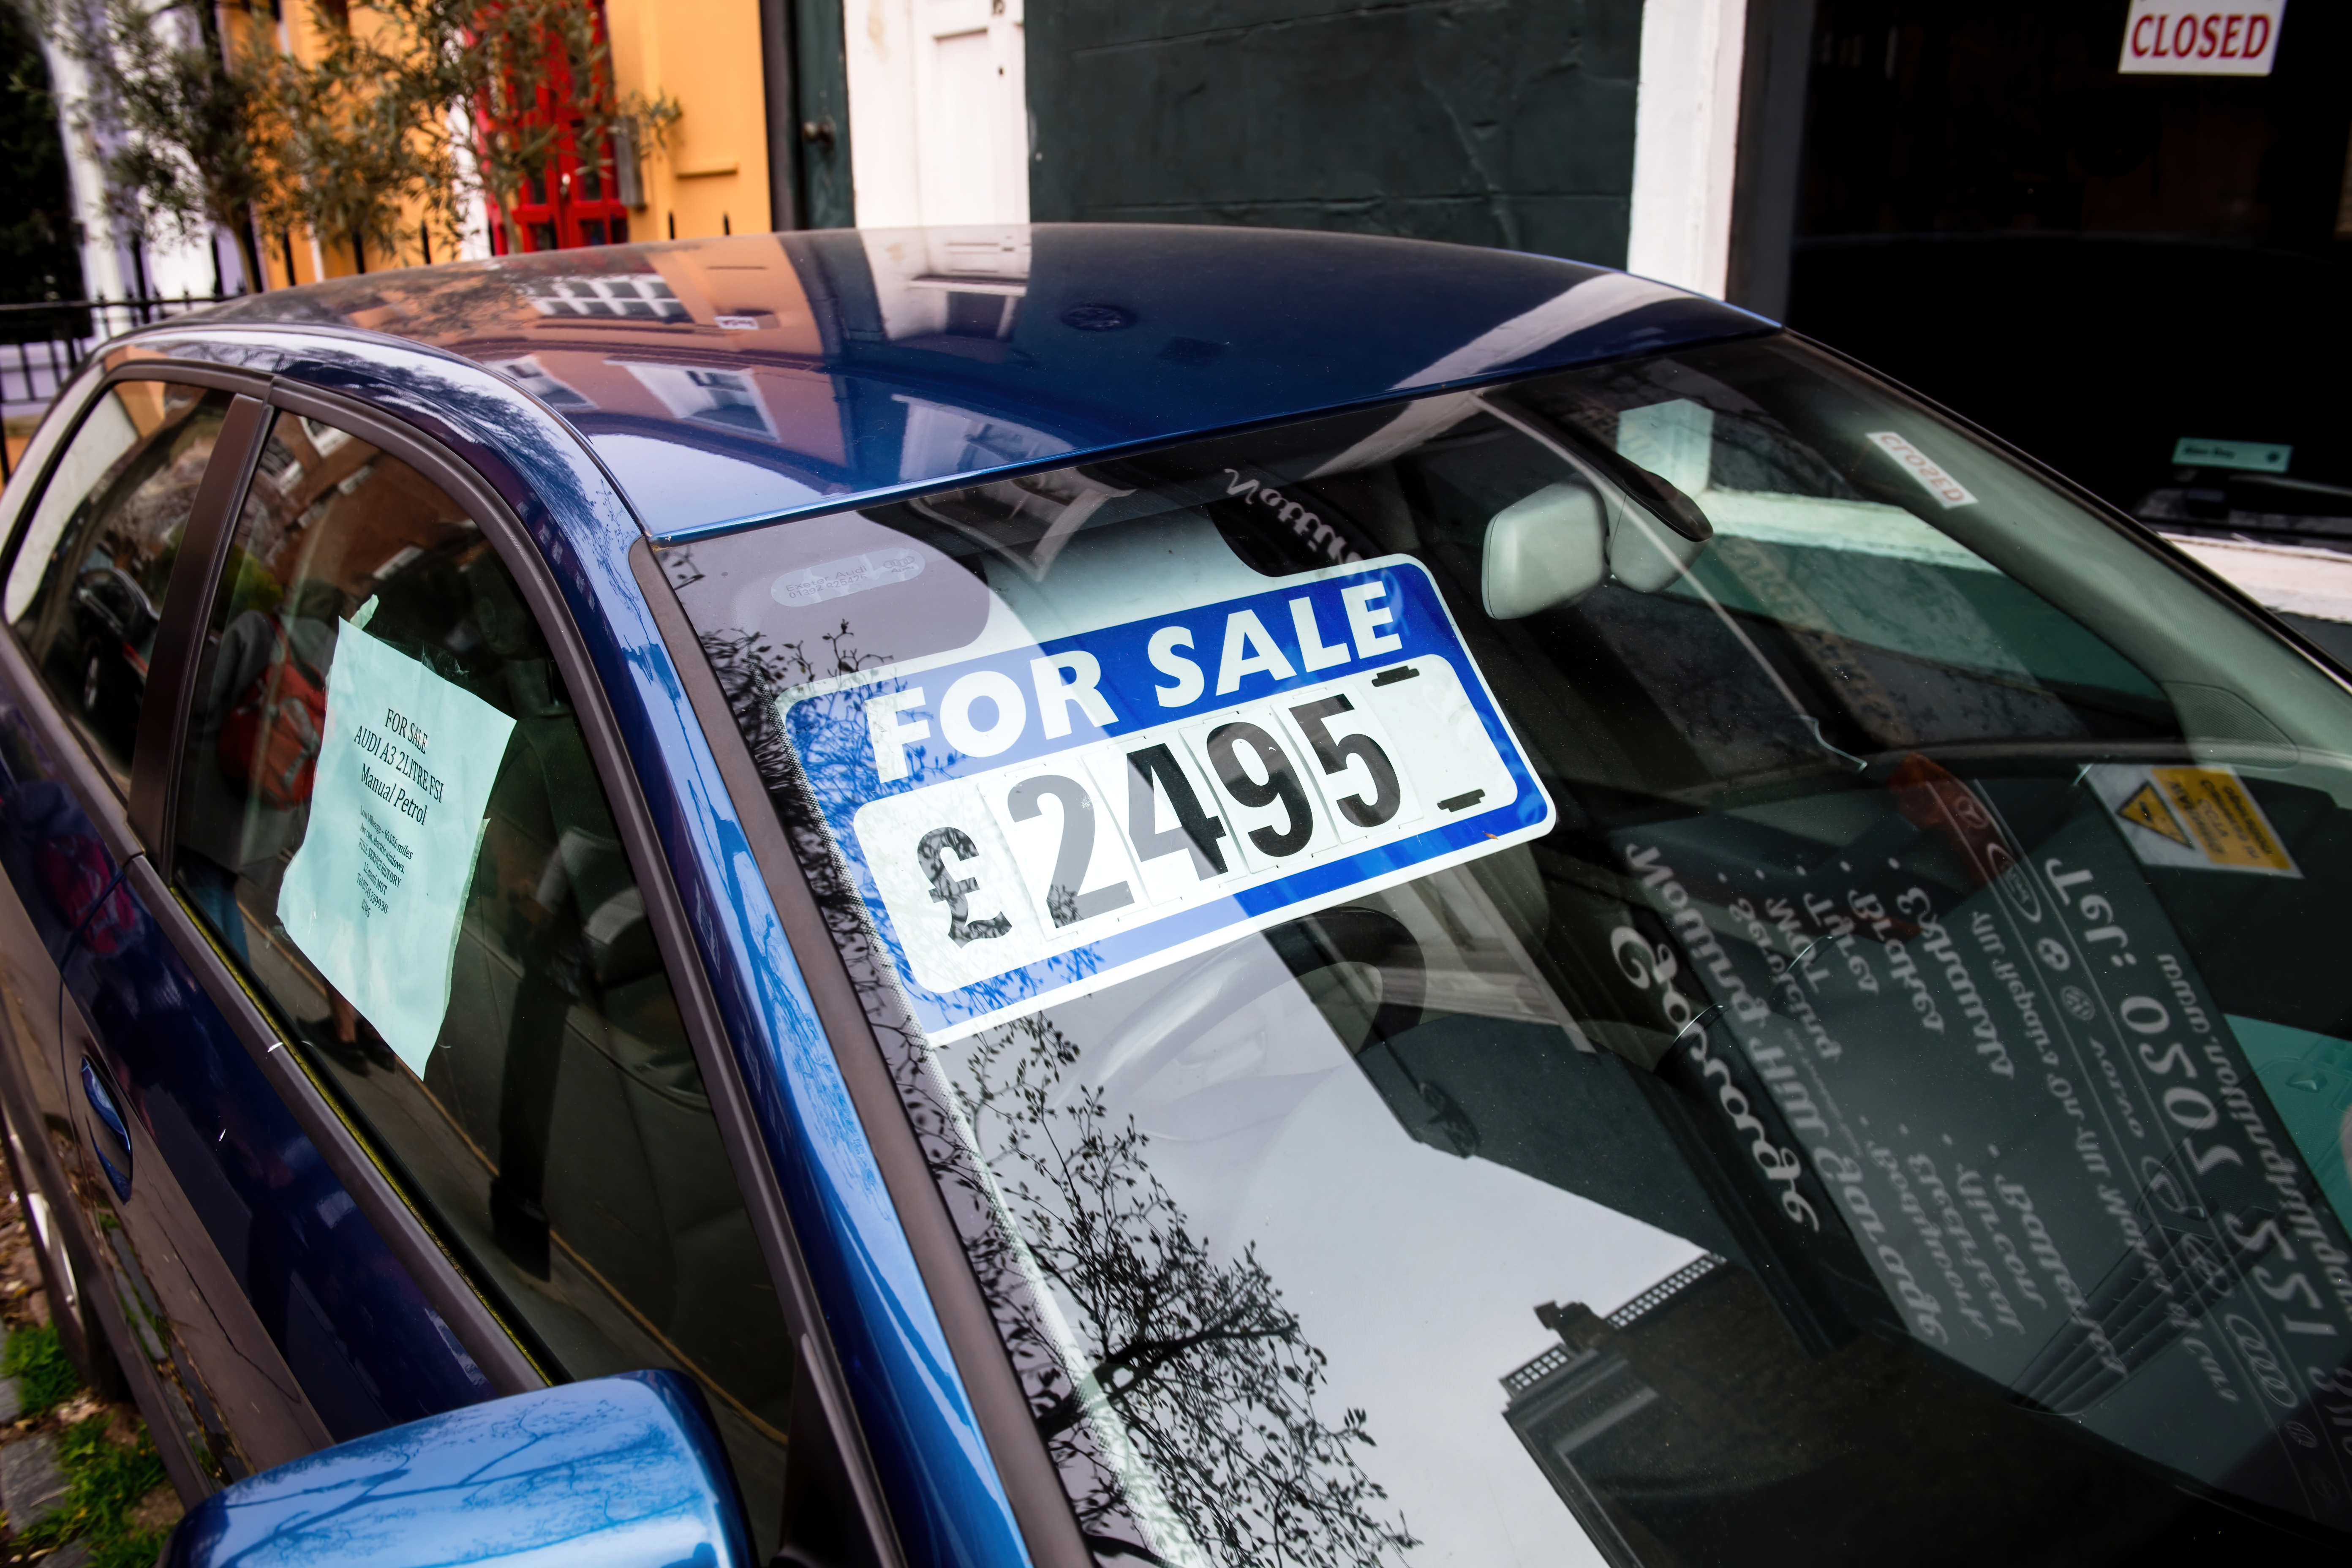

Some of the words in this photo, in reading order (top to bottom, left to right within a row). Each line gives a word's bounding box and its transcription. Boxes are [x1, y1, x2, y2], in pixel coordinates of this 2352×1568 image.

[2132, 13, 2272, 59] CLOSED
[786, 576, 829, 591] Exeter
[836, 566, 867, 579] Audi
[789, 585, 824, 598] 01392
[826, 574, 867, 589] 825425
[864, 651, 1119, 783] FOR
[1146, 580, 1403, 708] SALE
[385, 708, 408, 738] FOR
[408, 723, 428, 754] SALE
[354, 725, 382, 756] AUDI
[379, 742, 396, 765] A3
[395, 751, 428, 792] 2LITRE
[429, 775, 444, 803] FSI
[361, 762, 397, 803] Manual
[393, 788, 427, 826] Petrol
[368, 813, 381, 834] Mileage
[384, 829, 397, 849] 65,056
[397, 843, 413, 860] miles
[917, 693, 1401, 947] £2495
[358, 838, 368, 855] FULL
[368, 847, 382, 871] SERVICE
[380, 862, 401, 888] HISTORY
[373, 836, 387, 856] electric
[386, 851, 404, 874] windows.
[363, 862, 369, 874] 12
[367, 868, 377, 886] month
[376, 878, 387, 896] MOT
[370, 891, 388, 914] 339930
